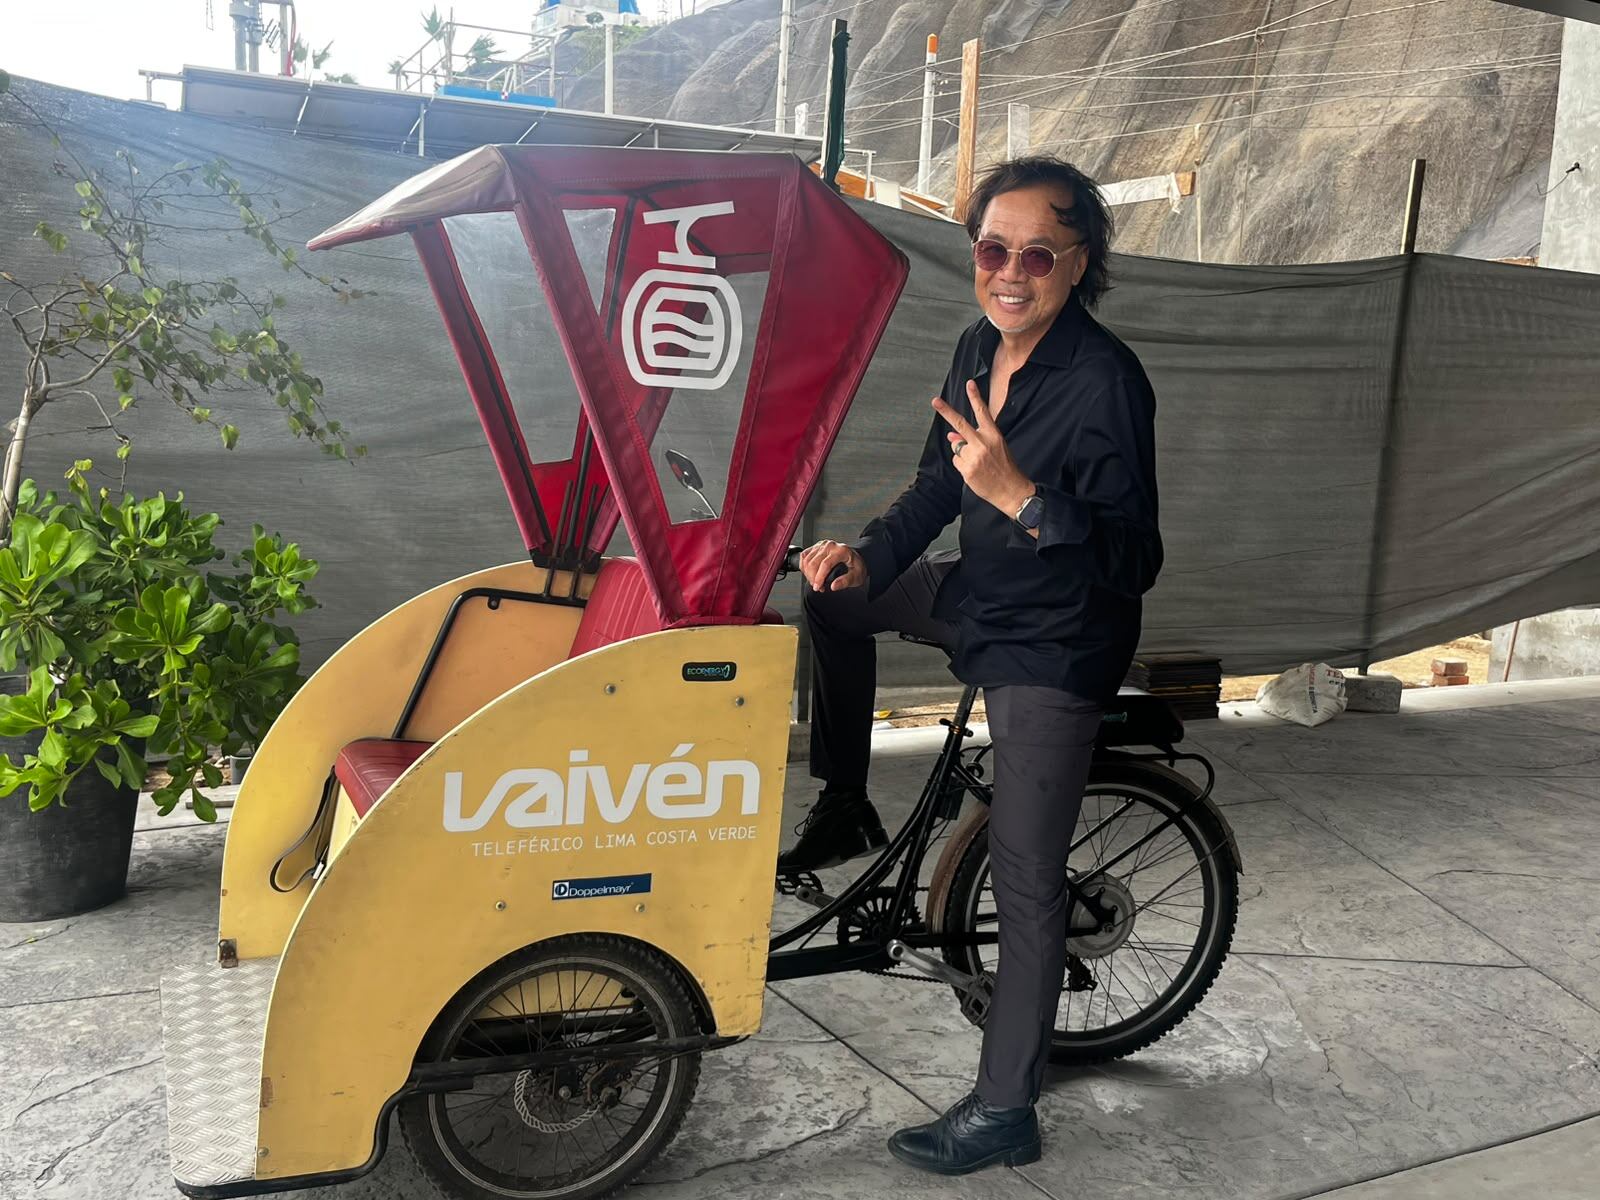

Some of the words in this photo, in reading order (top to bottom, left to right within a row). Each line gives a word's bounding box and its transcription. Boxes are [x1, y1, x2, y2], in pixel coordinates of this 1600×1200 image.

[472, 836, 584, 857] TELEFÉRICO
[595, 834, 636, 849] LIMA
[646, 831, 698, 846] COSTA
[708, 826, 757, 841] VERDE
[569, 885, 631, 897] Doppelmayr
